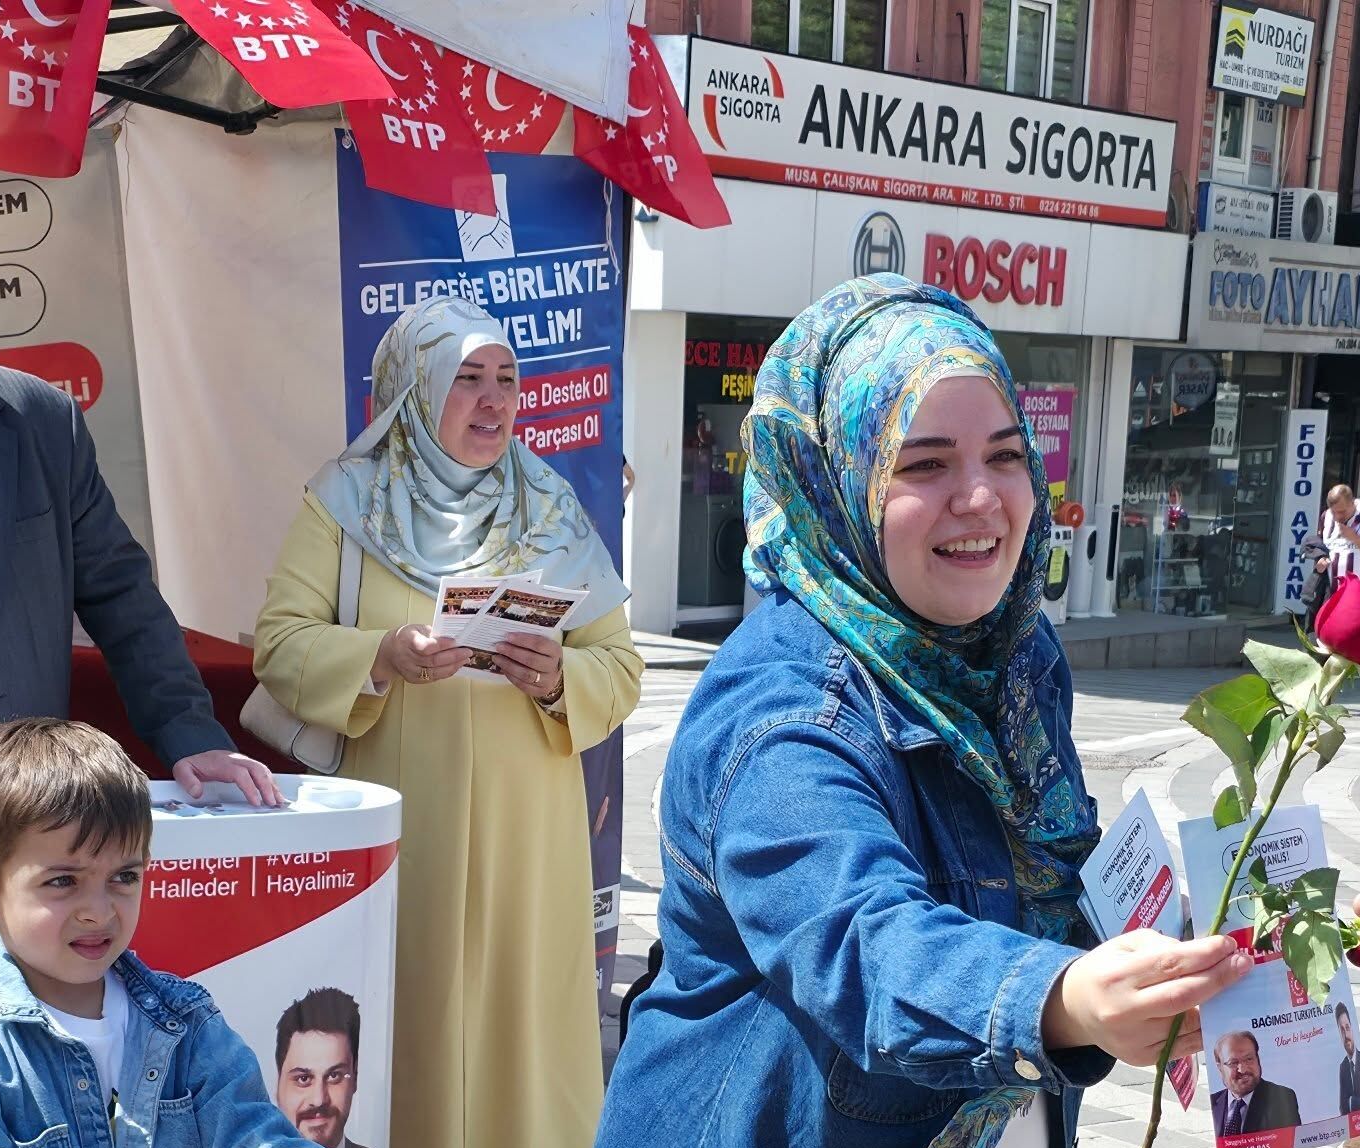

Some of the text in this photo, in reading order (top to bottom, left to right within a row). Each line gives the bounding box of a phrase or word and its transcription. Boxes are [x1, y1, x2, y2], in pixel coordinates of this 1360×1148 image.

[232, 34, 320, 62] BTP
[1247, 20, 1307, 54] NURDAĞI
[8, 71, 61, 112] BT
[707, 69, 770, 97] ANKARA
[719, 95, 781, 123] SİGORTA
[382, 114, 446, 151] BTP
[798, 84, 1156, 191] ANKARA SİGORTA
[784, 167, 817, 184] MUSA
[823, 172, 878, 191] ÇALIŞKAN
[884, 178, 928, 198] SİGORTA
[933, 185, 955, 200] ARA.
[984, 194, 1004, 208] LTD.
[923, 232, 1067, 307] BOSCH
[360, 258, 609, 314] GELECEĞE BİRLİKTE
[1209, 271, 1265, 310] FOTO
[541, 376, 591, 407] Destek
[1024, 396, 1058, 411] BOSCH
[525, 424, 581, 451] Parçası
[1038, 414, 1069, 432] EŞYADA
[1285, 424, 1315, 600] FOTO AYHAN
[150, 869, 355, 899] Halleder Hayalimiz
[1251, 1012, 1293, 1029] BAĞIMSIZ
